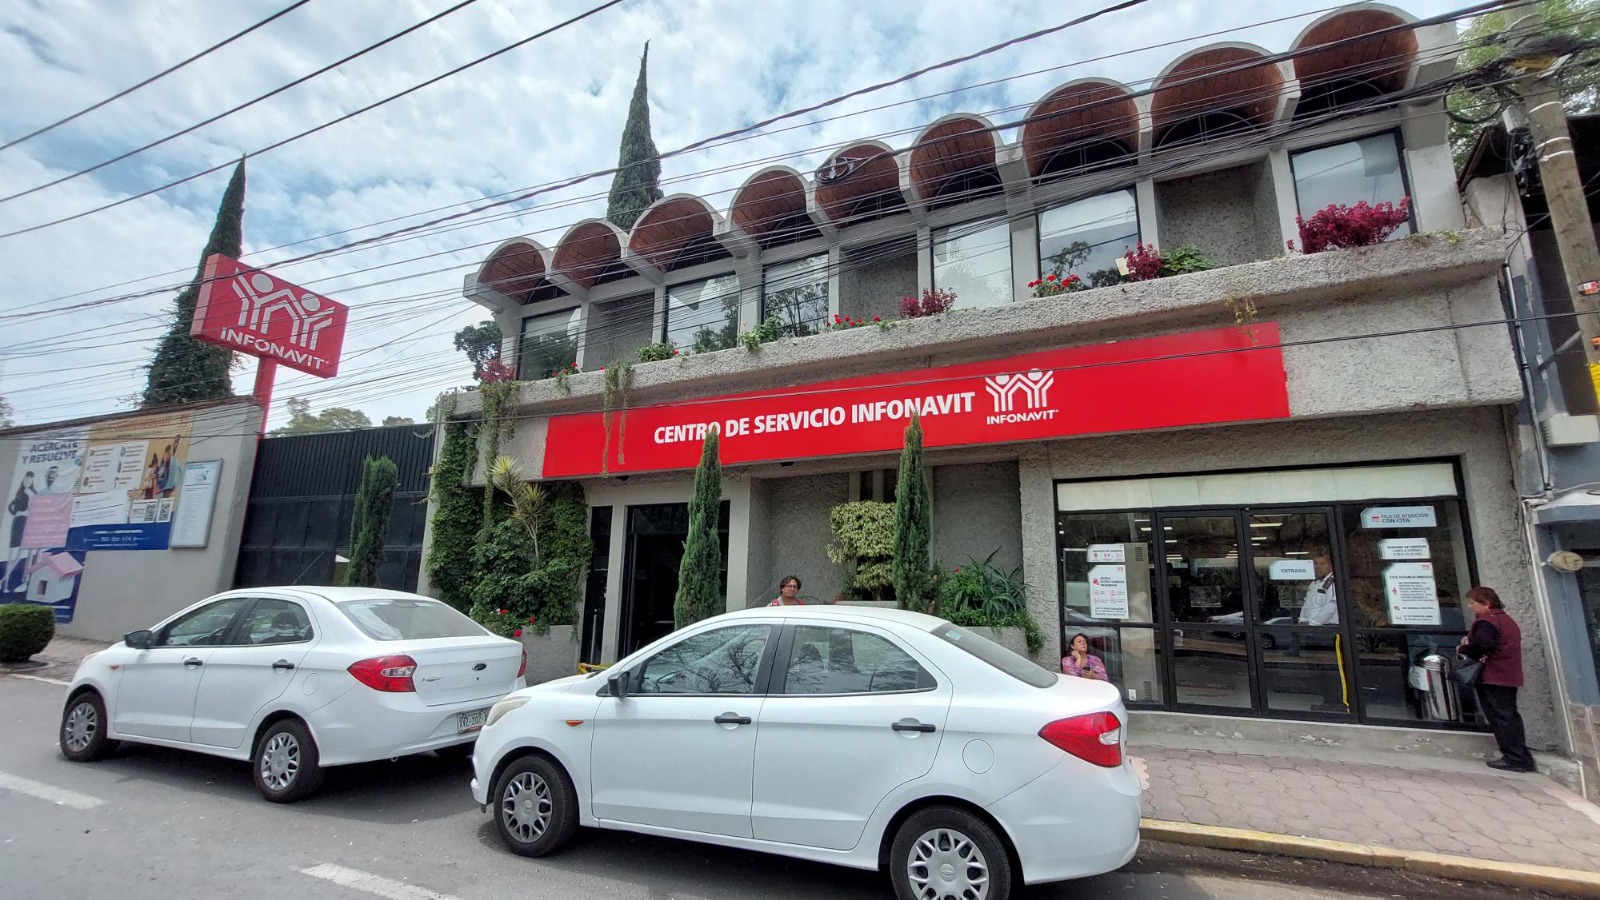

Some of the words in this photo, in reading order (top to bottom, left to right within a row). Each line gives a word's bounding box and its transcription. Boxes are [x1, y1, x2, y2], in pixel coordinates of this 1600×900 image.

[220, 326, 325, 370] INFONAVIT
[654, 421, 721, 444] CENTRO
[725, 417, 750, 438] DE
[753, 406, 846, 434] SERVICIO
[851, 392, 975, 424] INFONAVIT
[986, 409, 1055, 425] INFONAVIT
[22, 455, 30, 464] Y
[29, 449, 78, 464] RESUELVE
